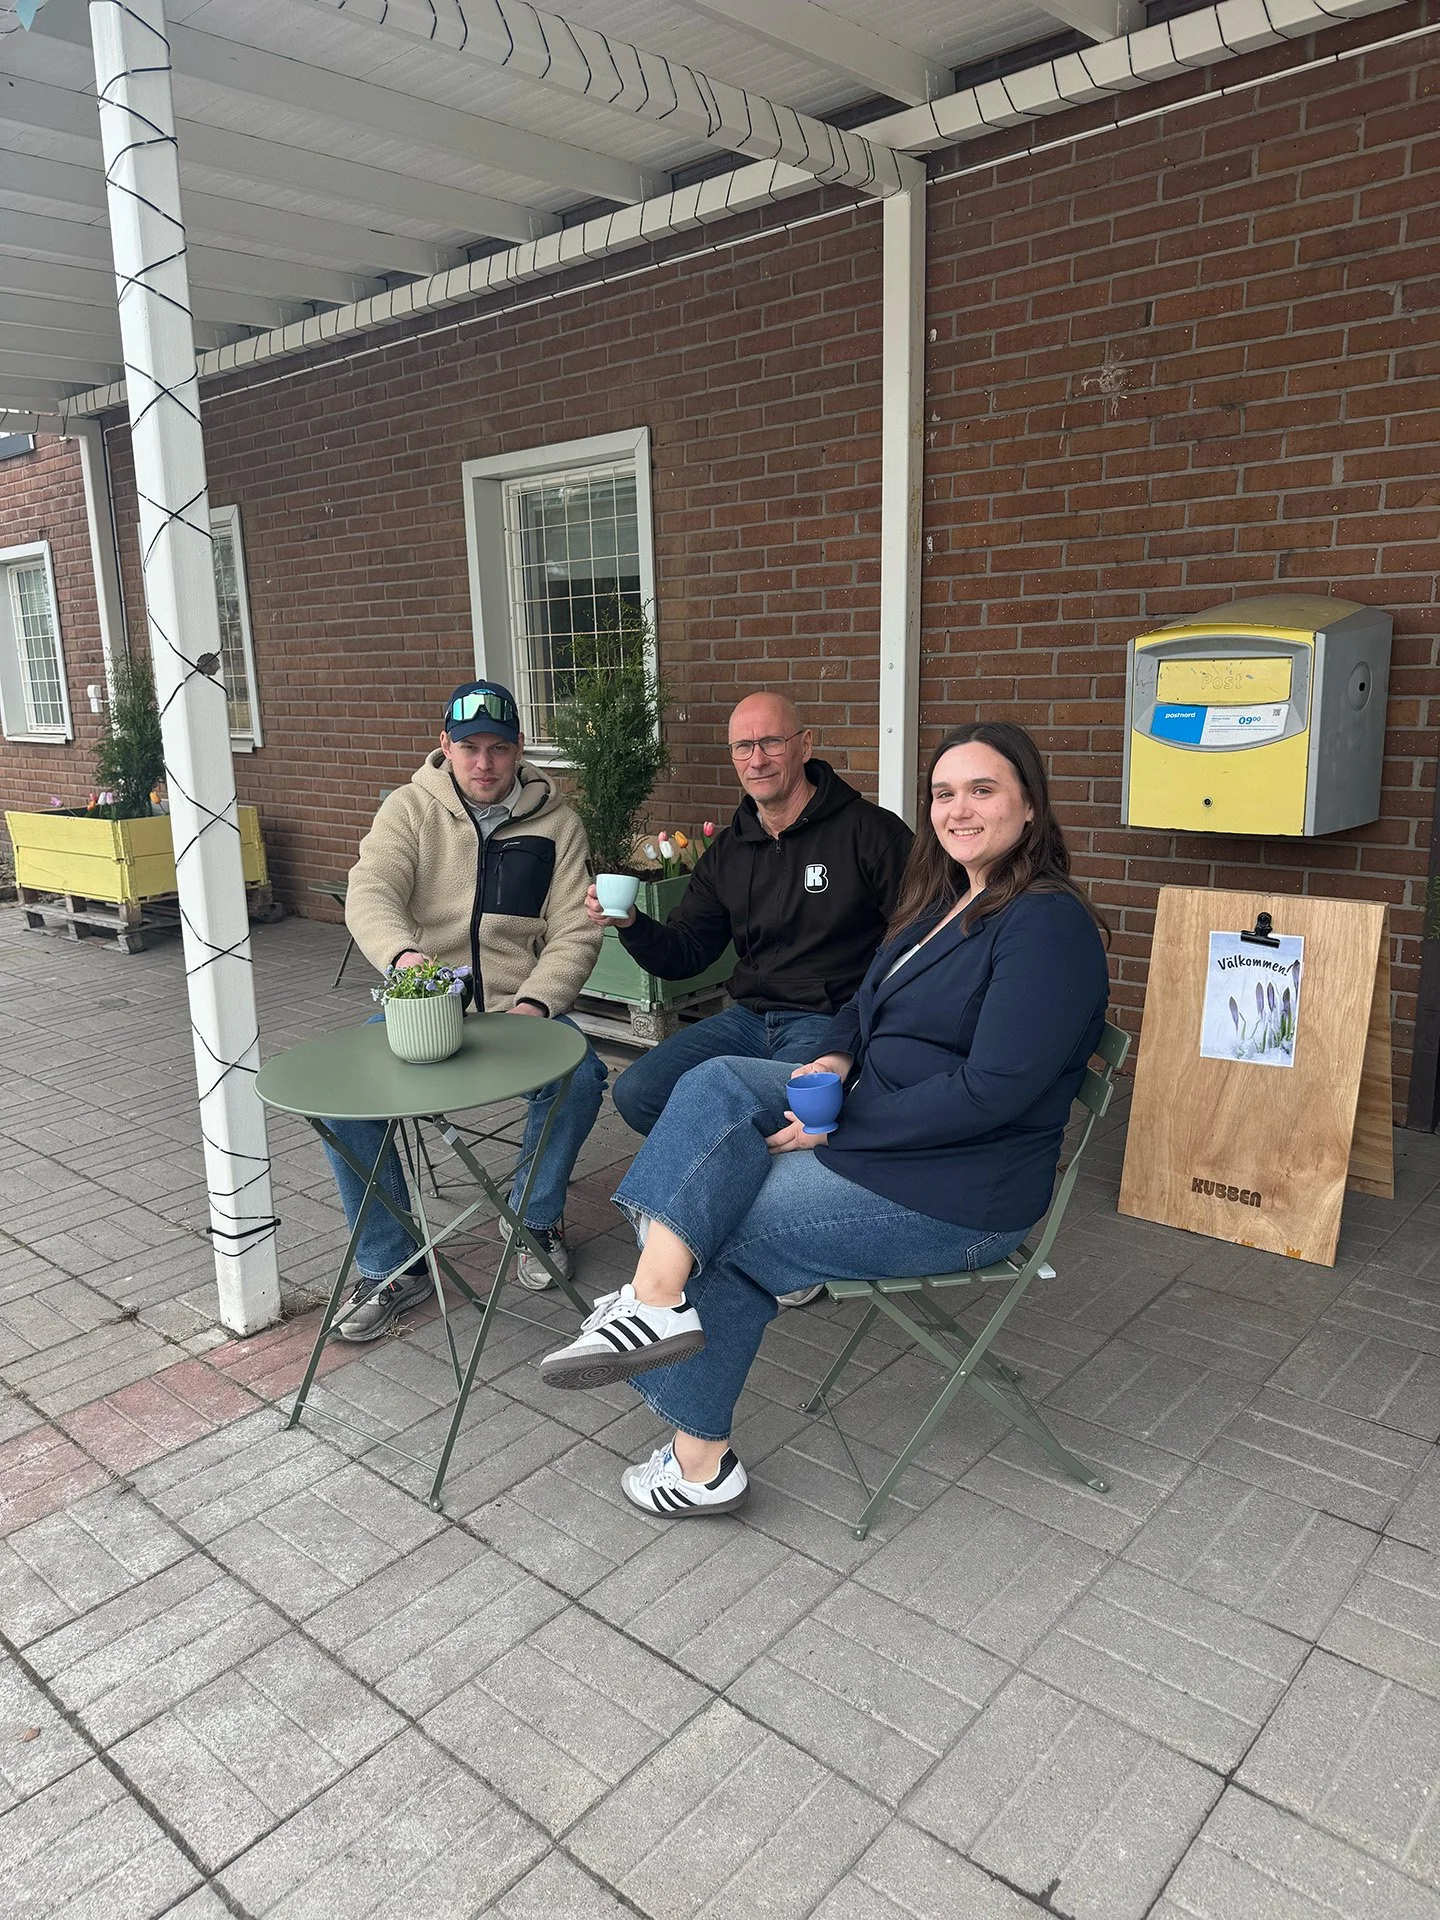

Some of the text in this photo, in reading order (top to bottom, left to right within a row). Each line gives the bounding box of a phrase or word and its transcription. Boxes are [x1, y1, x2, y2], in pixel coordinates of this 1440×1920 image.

[1201, 673, 1242, 690] Post
[1217, 954, 1294, 976] Välkommen!
[1191, 1177, 1262, 1208] KUBBEN
